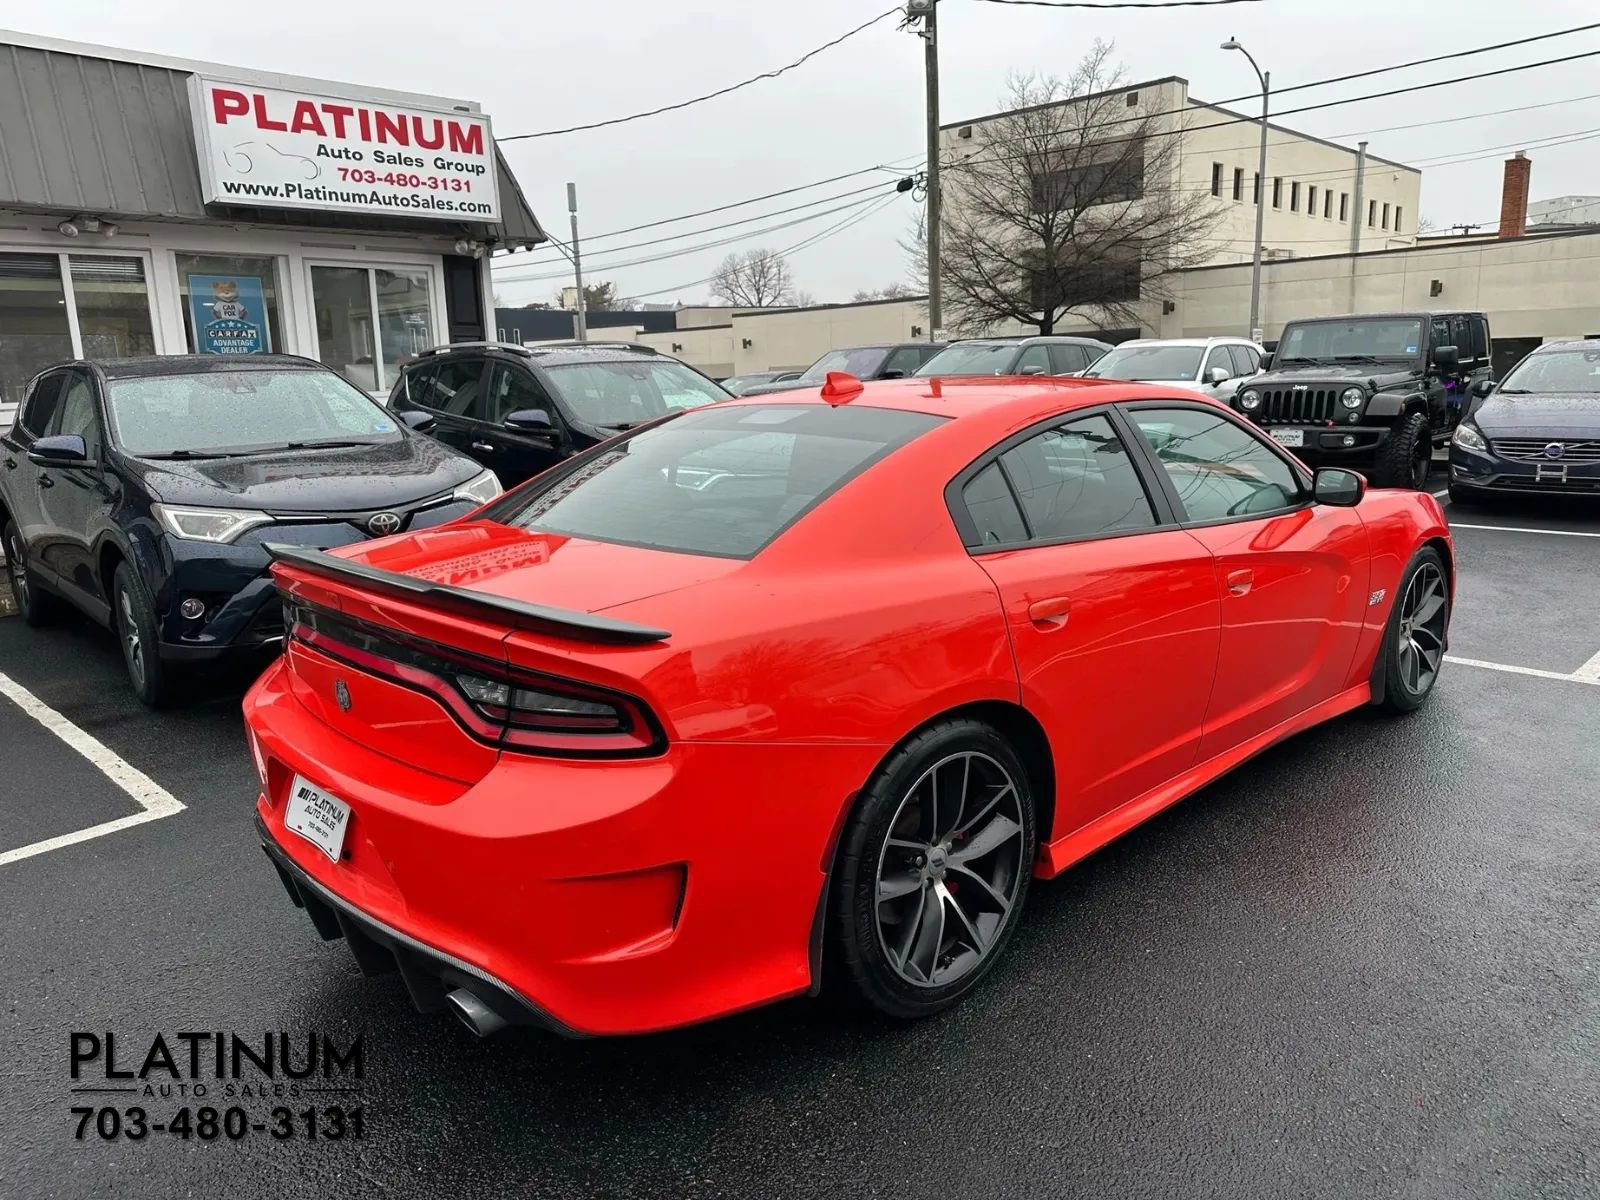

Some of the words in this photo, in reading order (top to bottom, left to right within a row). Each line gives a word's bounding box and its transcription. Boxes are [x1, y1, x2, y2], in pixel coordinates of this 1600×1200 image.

[211, 88, 484, 155] PLATINUM
[316, 144, 363, 161] Auto
[373, 150, 424, 168] Sales
[434, 157, 486, 176] Group
[337, 168, 472, 193] 703-480-3131
[223, 181, 492, 215] www.PlatinumAutoSales.com
[208, 329, 257, 339] CARFAX
[213, 339, 255, 347] ADVANTAGE
[221, 346, 248, 354] DEALER
[304, 805, 321, 819] AUTO
[320, 814, 336, 831] SALES
[308, 792, 345, 824] PLATINUM
